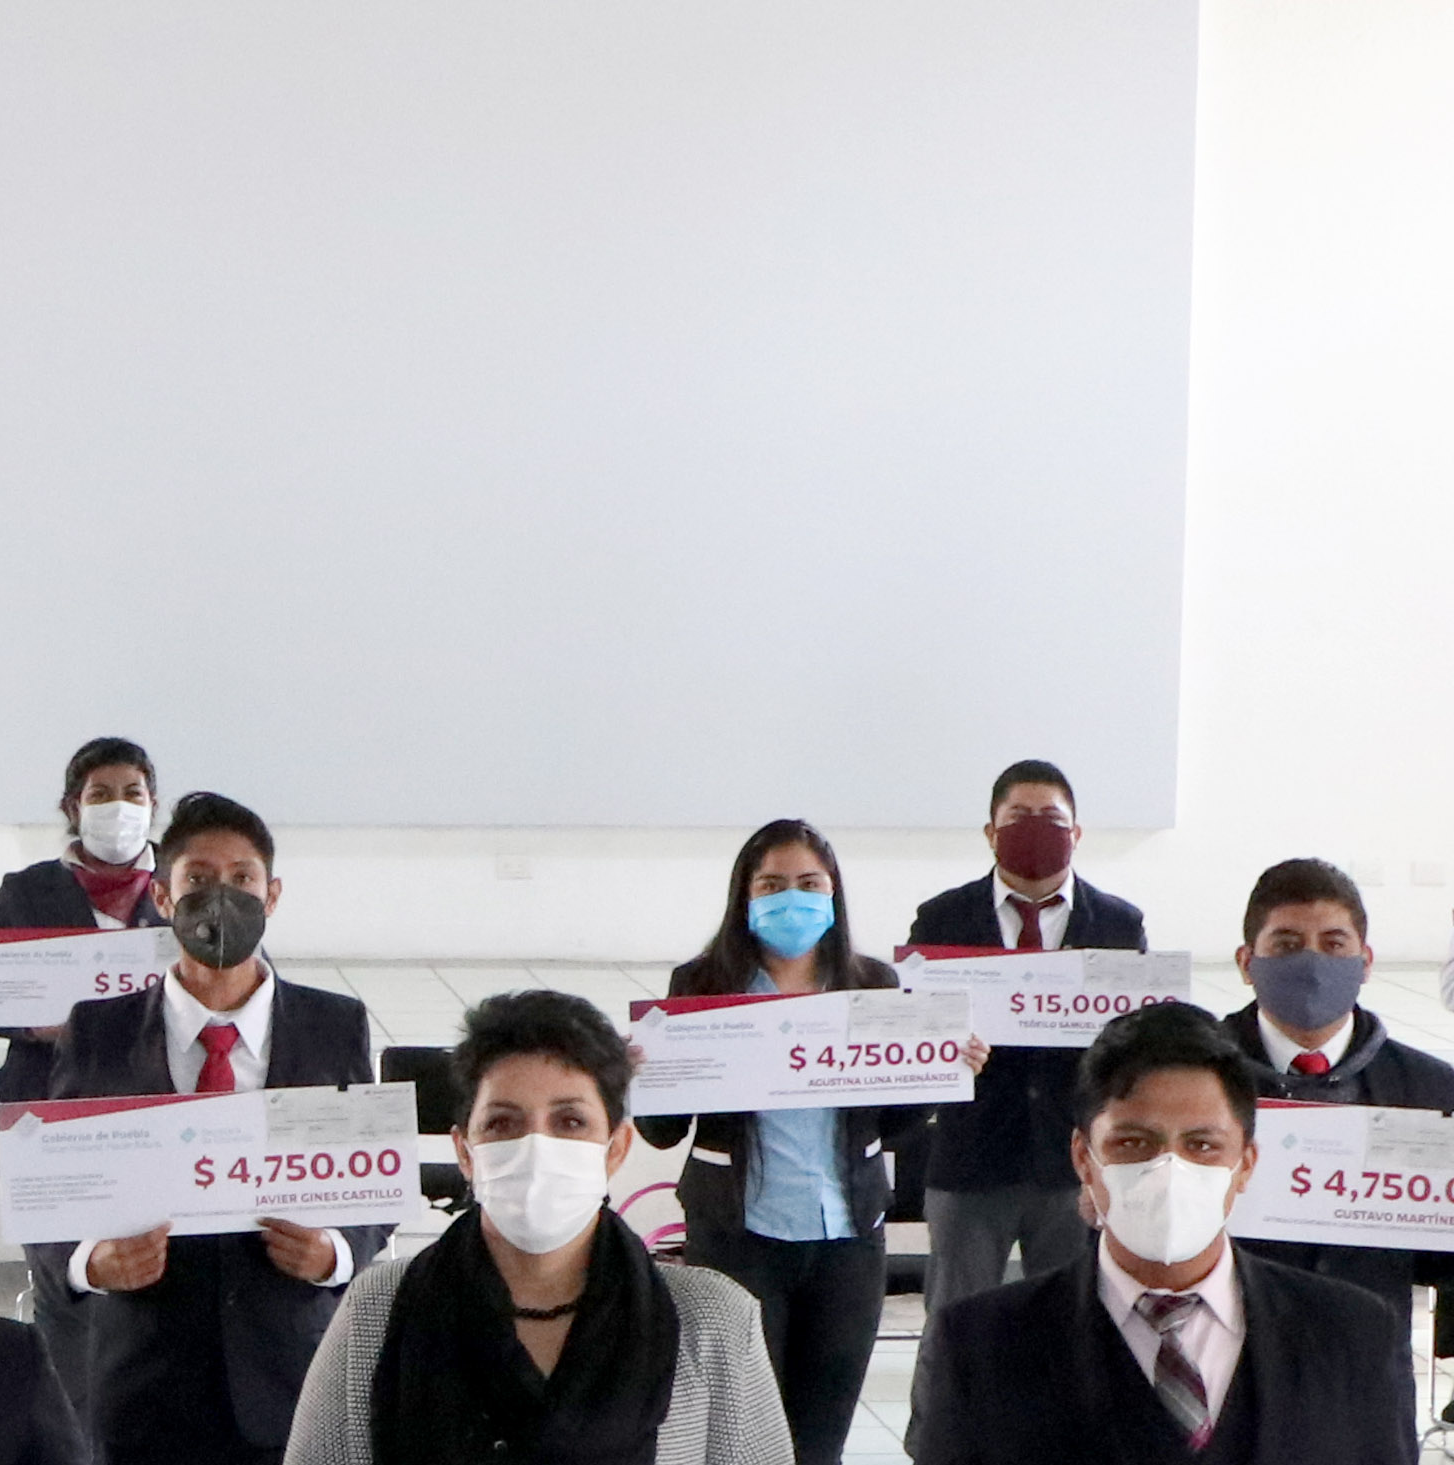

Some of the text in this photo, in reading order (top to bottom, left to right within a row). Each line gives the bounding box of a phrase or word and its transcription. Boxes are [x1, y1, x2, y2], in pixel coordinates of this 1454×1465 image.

[95, 971, 110, 995] $
[1010, 992, 1025, 1015] $
[789, 1040, 960, 1071] $ 4,750.00
[194, 1149, 402, 1188] $ 4,750.00
[1291, 1163, 1312, 1197] $
[255, 1188, 403, 1206] JAVIER GINES CASTILLO
[1334, 1209, 1393, 1222] GUSTAVO
